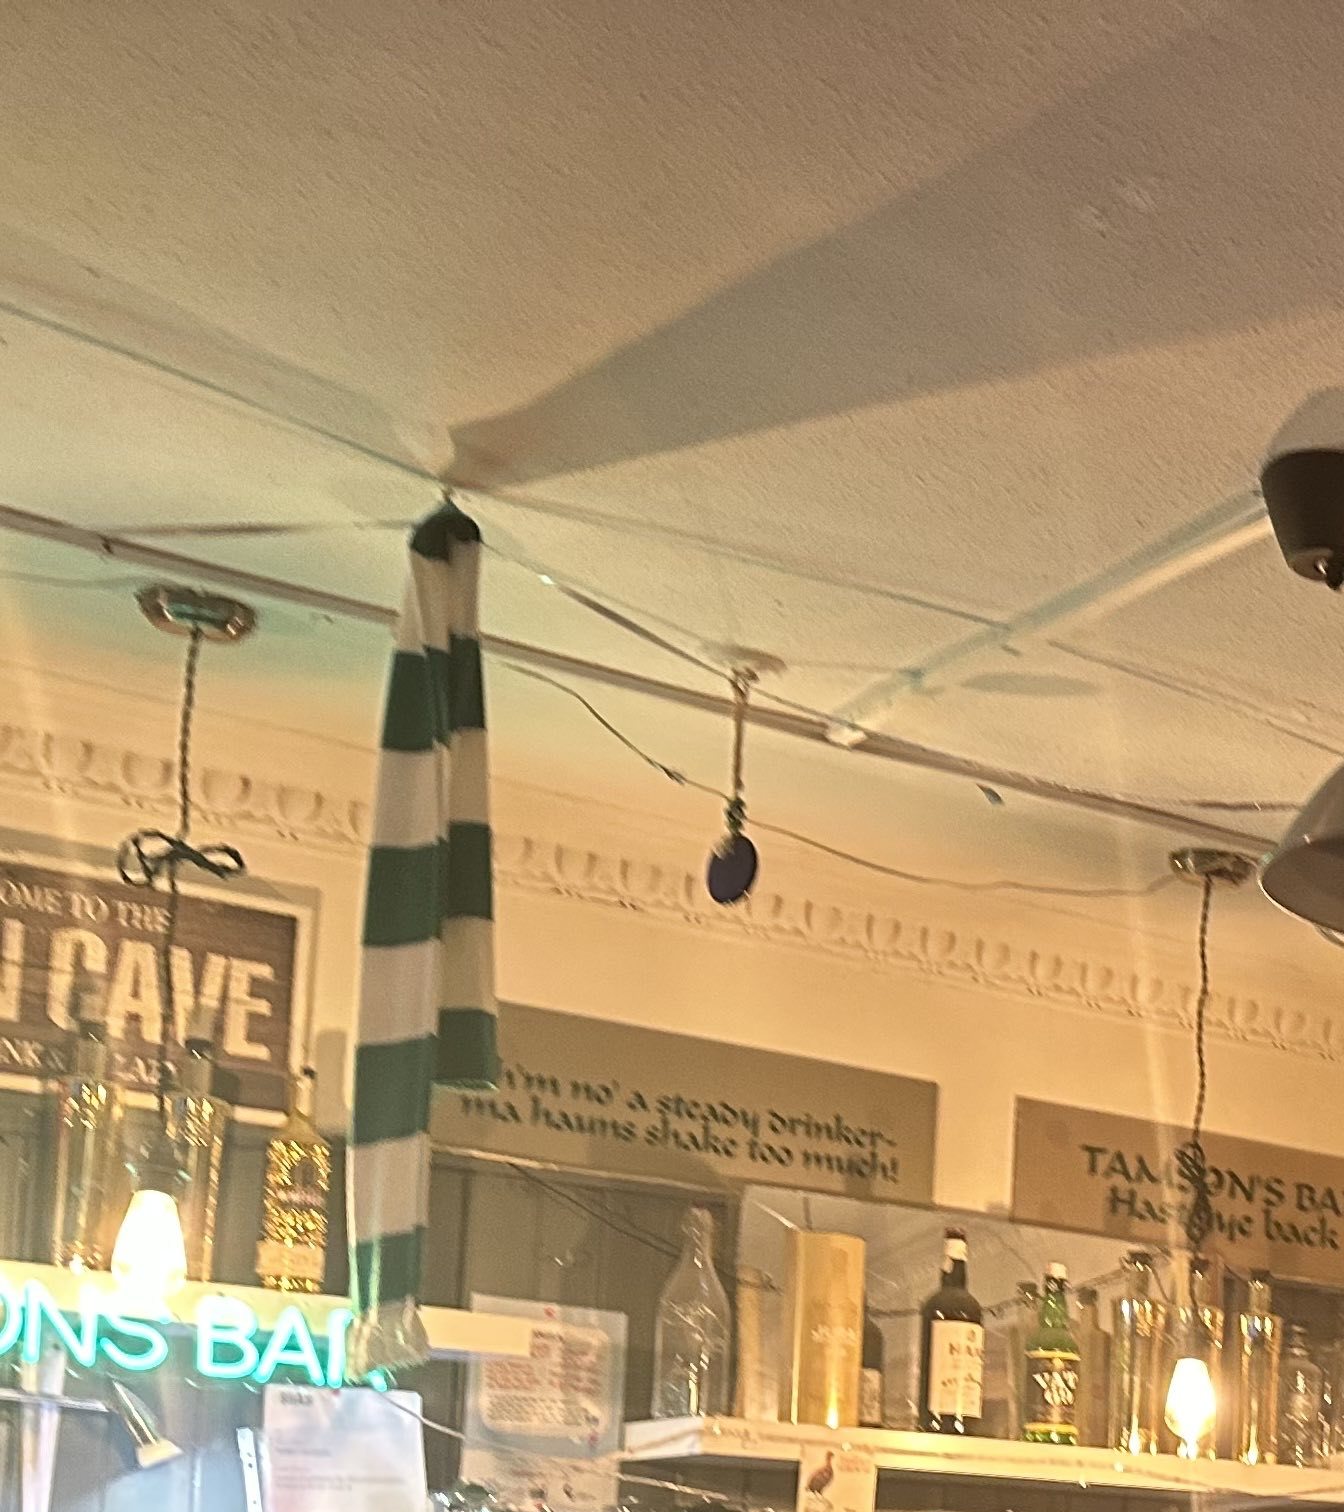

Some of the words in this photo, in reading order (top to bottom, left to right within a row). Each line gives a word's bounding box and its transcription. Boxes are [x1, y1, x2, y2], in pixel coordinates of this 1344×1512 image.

[47, 926, 276, 1062] CAVE
[460, 1094, 522, 1125] ma
[644, 1112, 738, 1160] shake
[748, 1136, 795, 1168] too
[656, 1092, 761, 1138] steady
[1262, 1206, 1341, 1251] back
